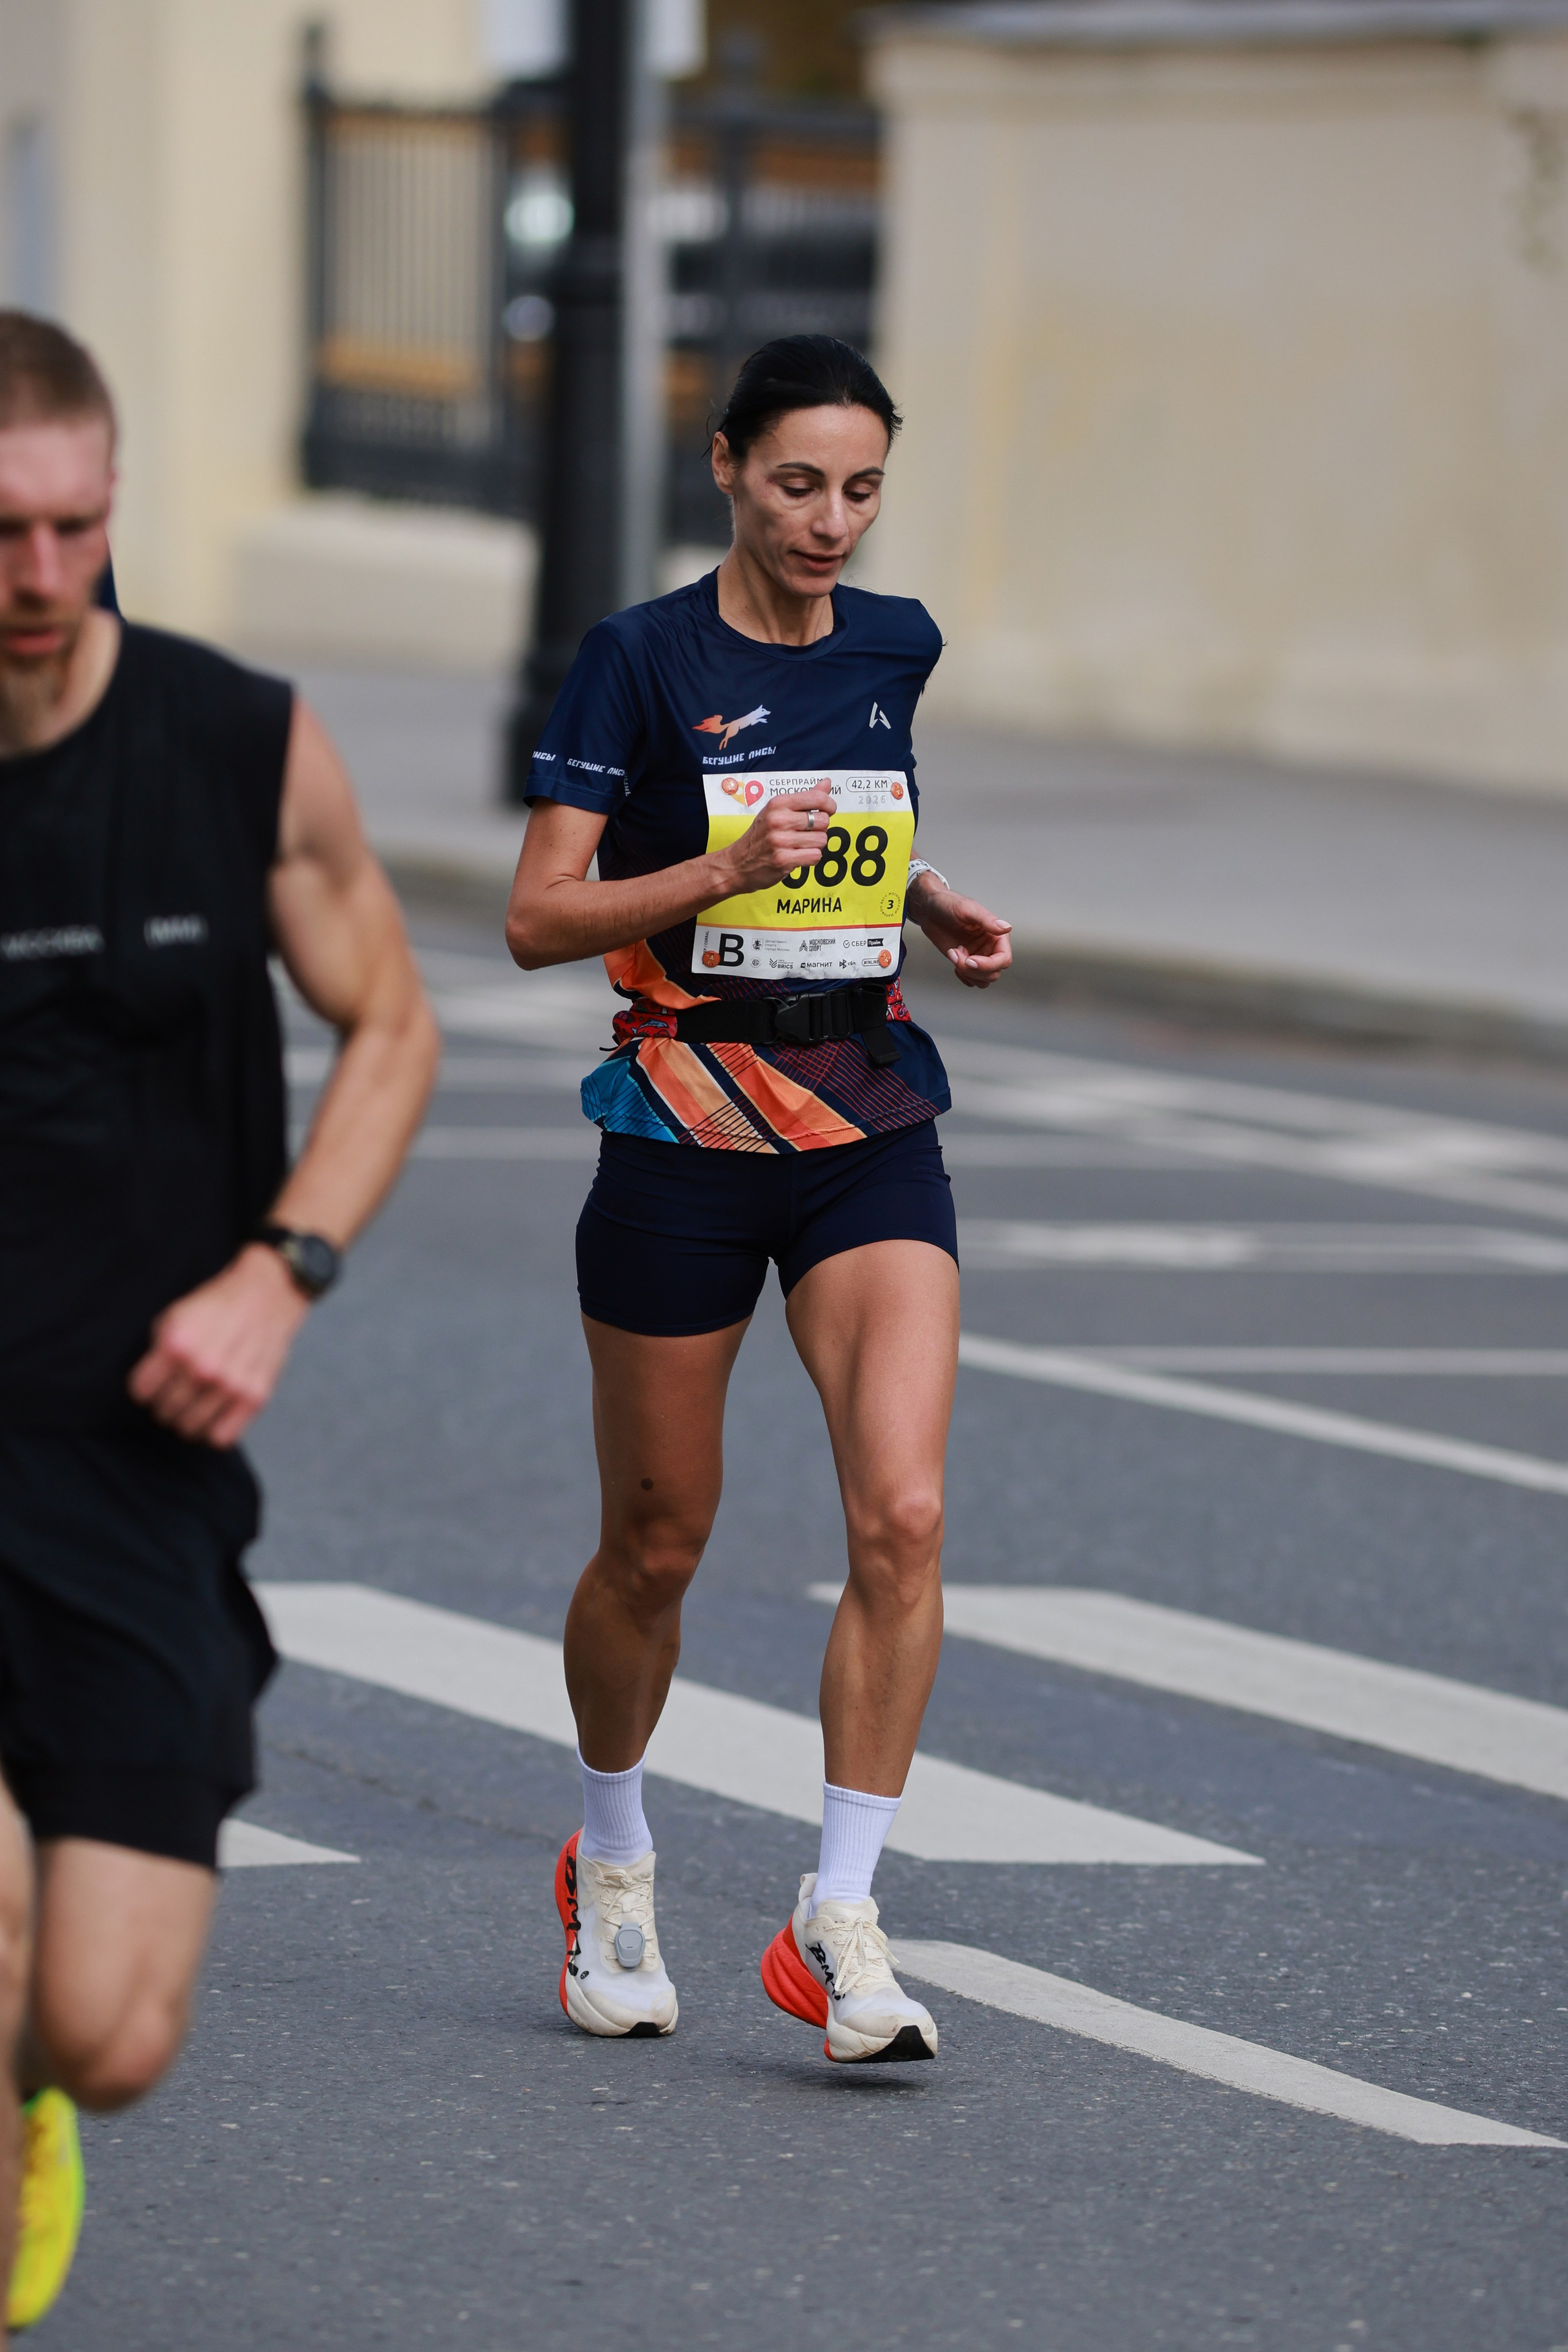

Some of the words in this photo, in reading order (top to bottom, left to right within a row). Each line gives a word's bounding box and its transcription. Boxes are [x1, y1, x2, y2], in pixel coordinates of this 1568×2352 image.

[532, 751, 556, 761] ИСЫ
[748, 746, 777, 760] ЛИСЫ
[770, 785, 842, 796] МОСКИЙ
[851, 780, 871, 790] 42,2
[858, 794, 886, 805] 2026
[782, 825, 889, 889] 88
[776, 897, 842, 914] МАРИНА
[887, 900, 894, 910] 3
[717, 933, 745, 967] B
